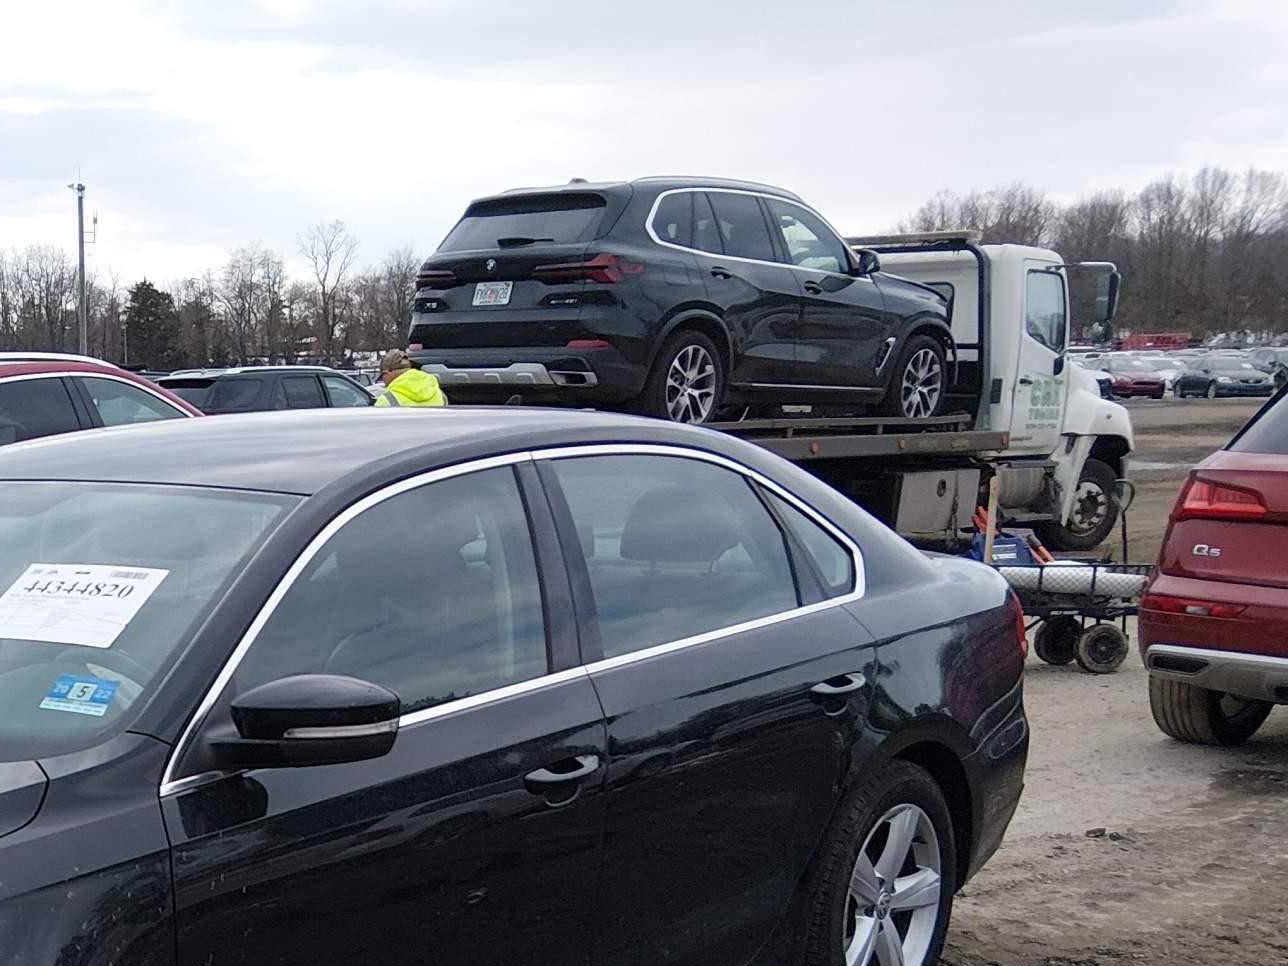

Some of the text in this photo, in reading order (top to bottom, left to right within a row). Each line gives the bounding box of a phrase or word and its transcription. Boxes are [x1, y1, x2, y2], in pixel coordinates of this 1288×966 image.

[1193, 544, 1221, 557] Q5
[23, 580, 135, 599] 44344820
[76, 686, 90, 698] 5
